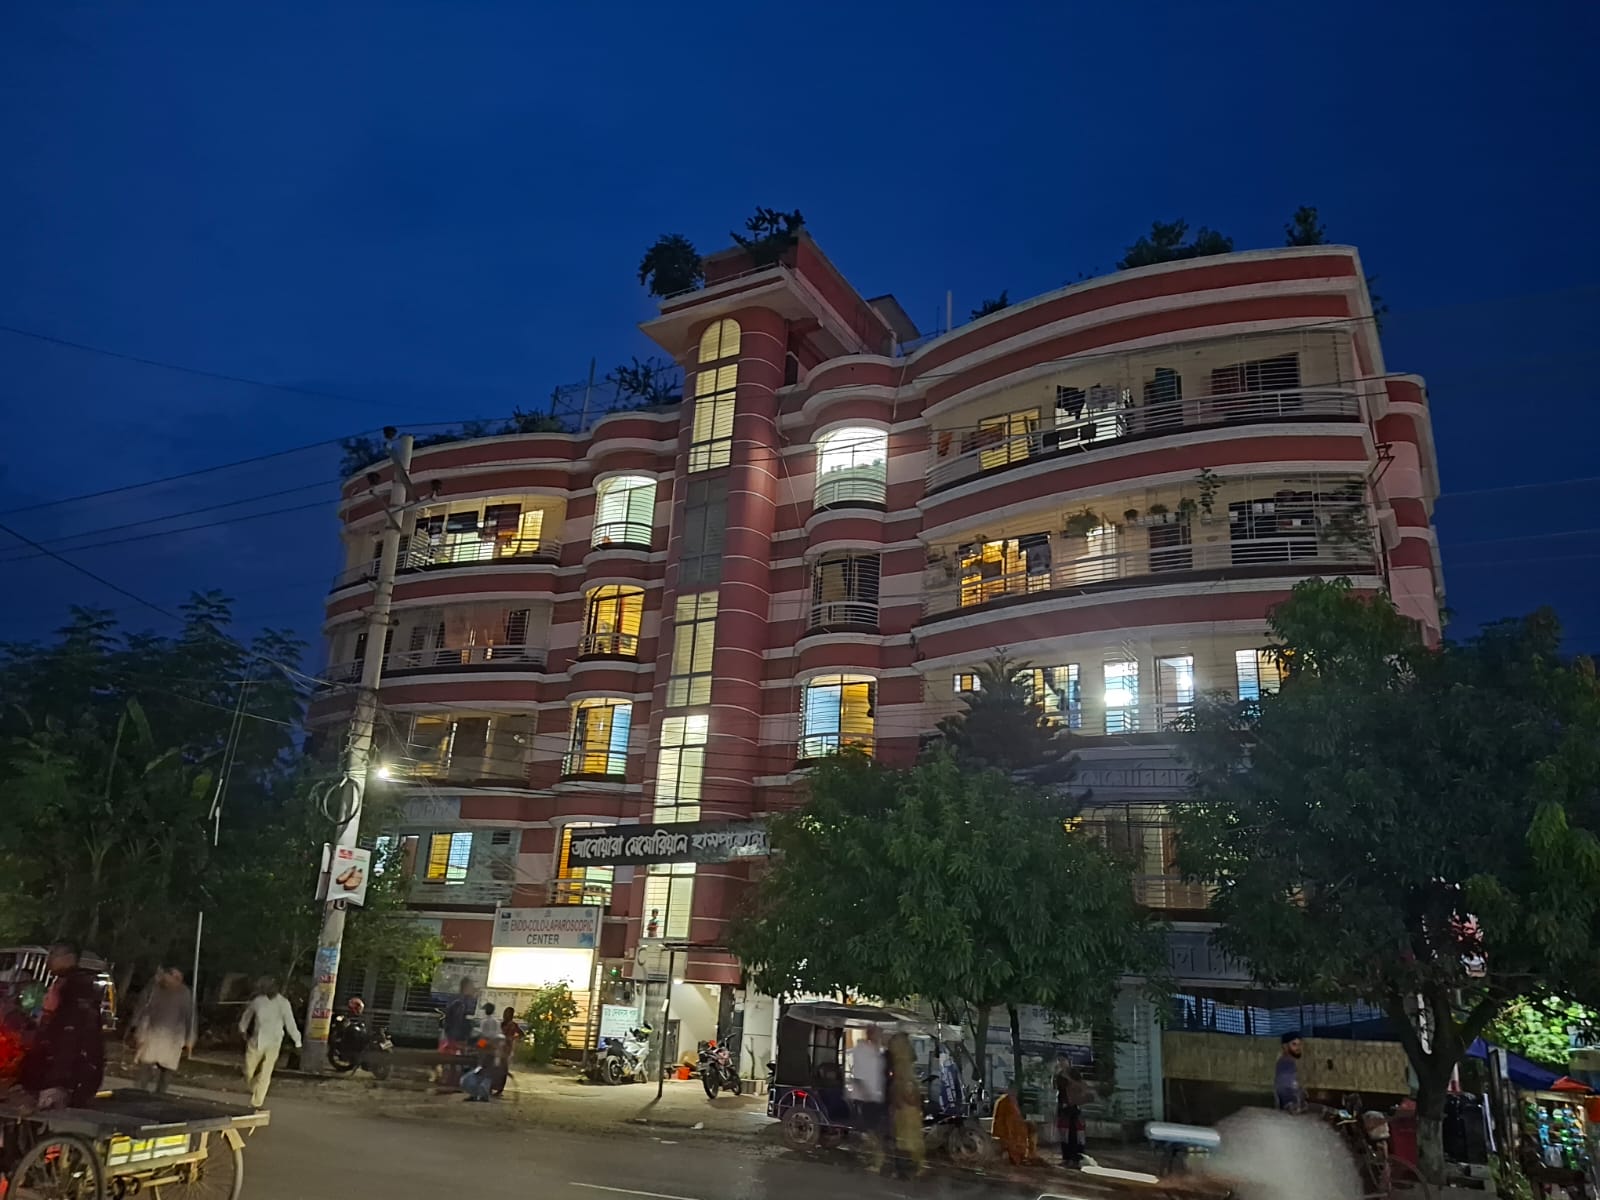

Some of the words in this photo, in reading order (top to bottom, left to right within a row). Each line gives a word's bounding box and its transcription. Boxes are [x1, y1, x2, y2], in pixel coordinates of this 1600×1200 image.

[571, 835, 624, 858] আনোয়ারা
[625, 829, 688, 857] মেমোরিয়াল
[526, 933, 560, 945] CENTER
